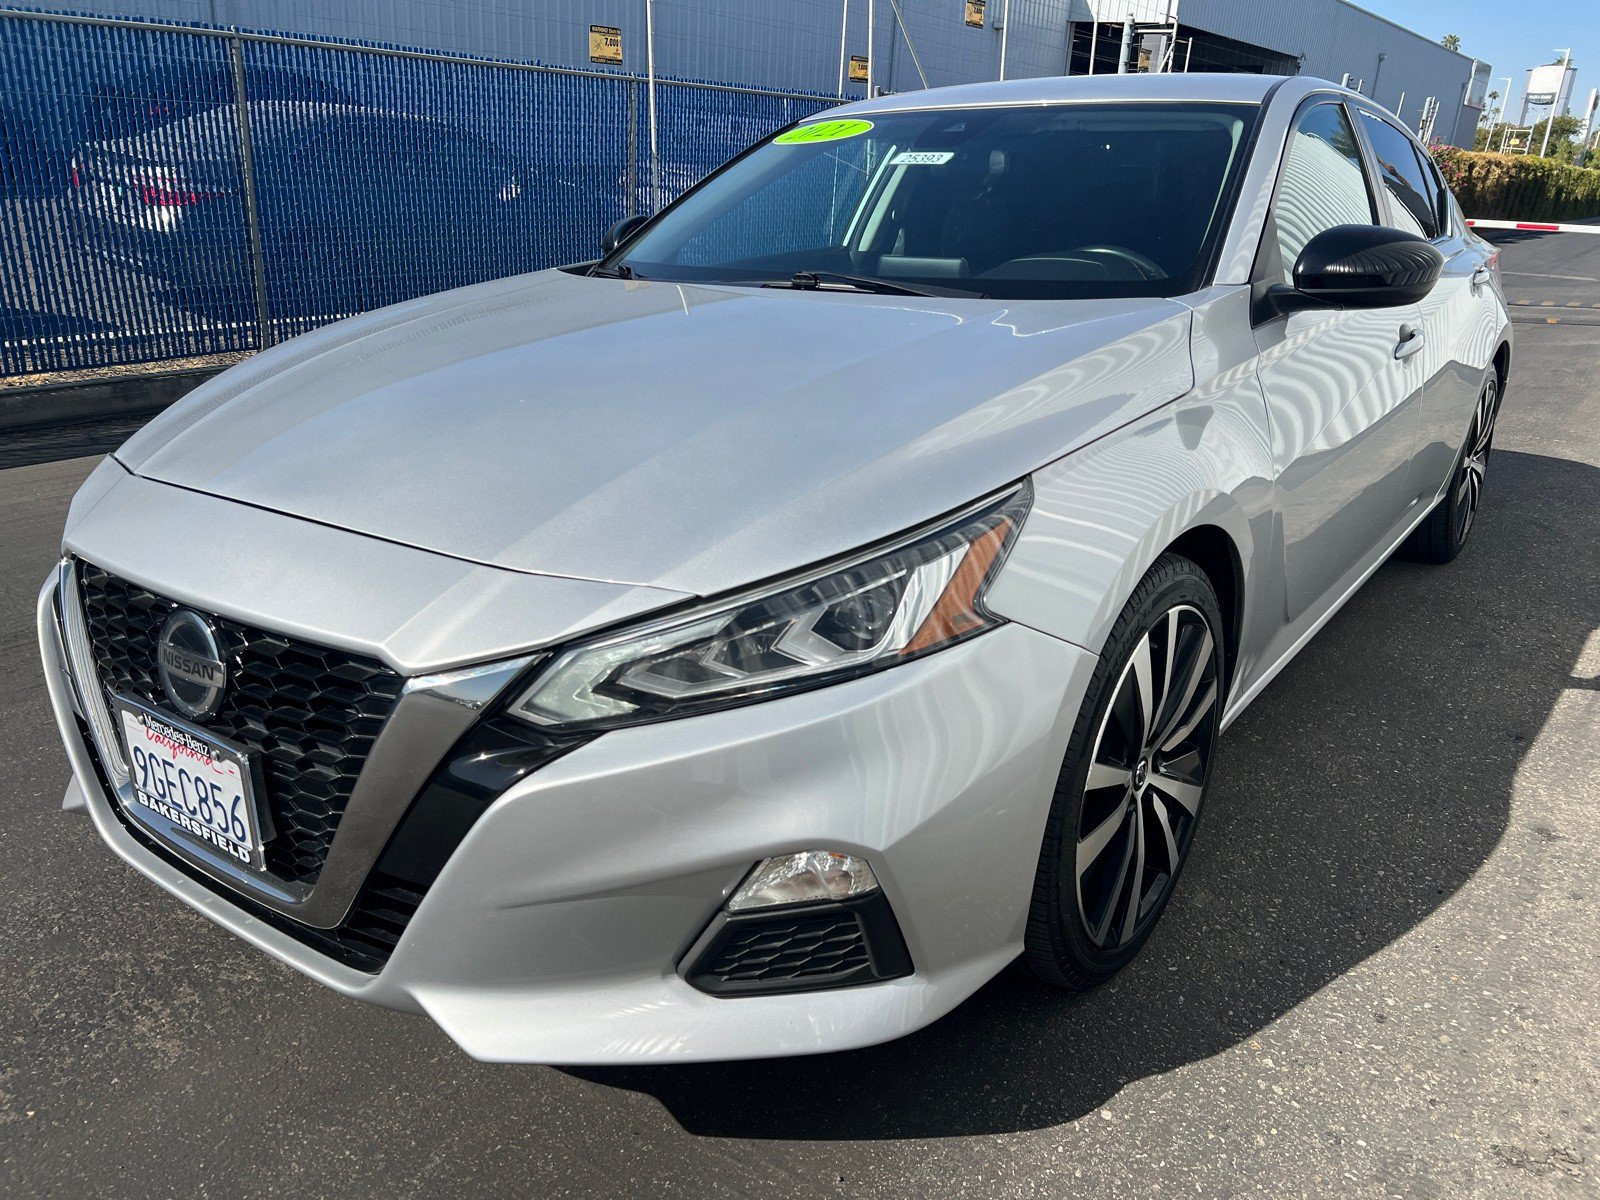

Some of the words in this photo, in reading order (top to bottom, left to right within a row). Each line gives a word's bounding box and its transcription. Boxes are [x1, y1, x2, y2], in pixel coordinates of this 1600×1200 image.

[900, 154, 944, 162] 25393
[163, 649, 214, 681] NISSAN
[143, 713, 210, 757] Mercedes-Benz
[133, 745, 247, 843] 9GEC856
[137, 789, 251, 864] BAKERSFIELD
